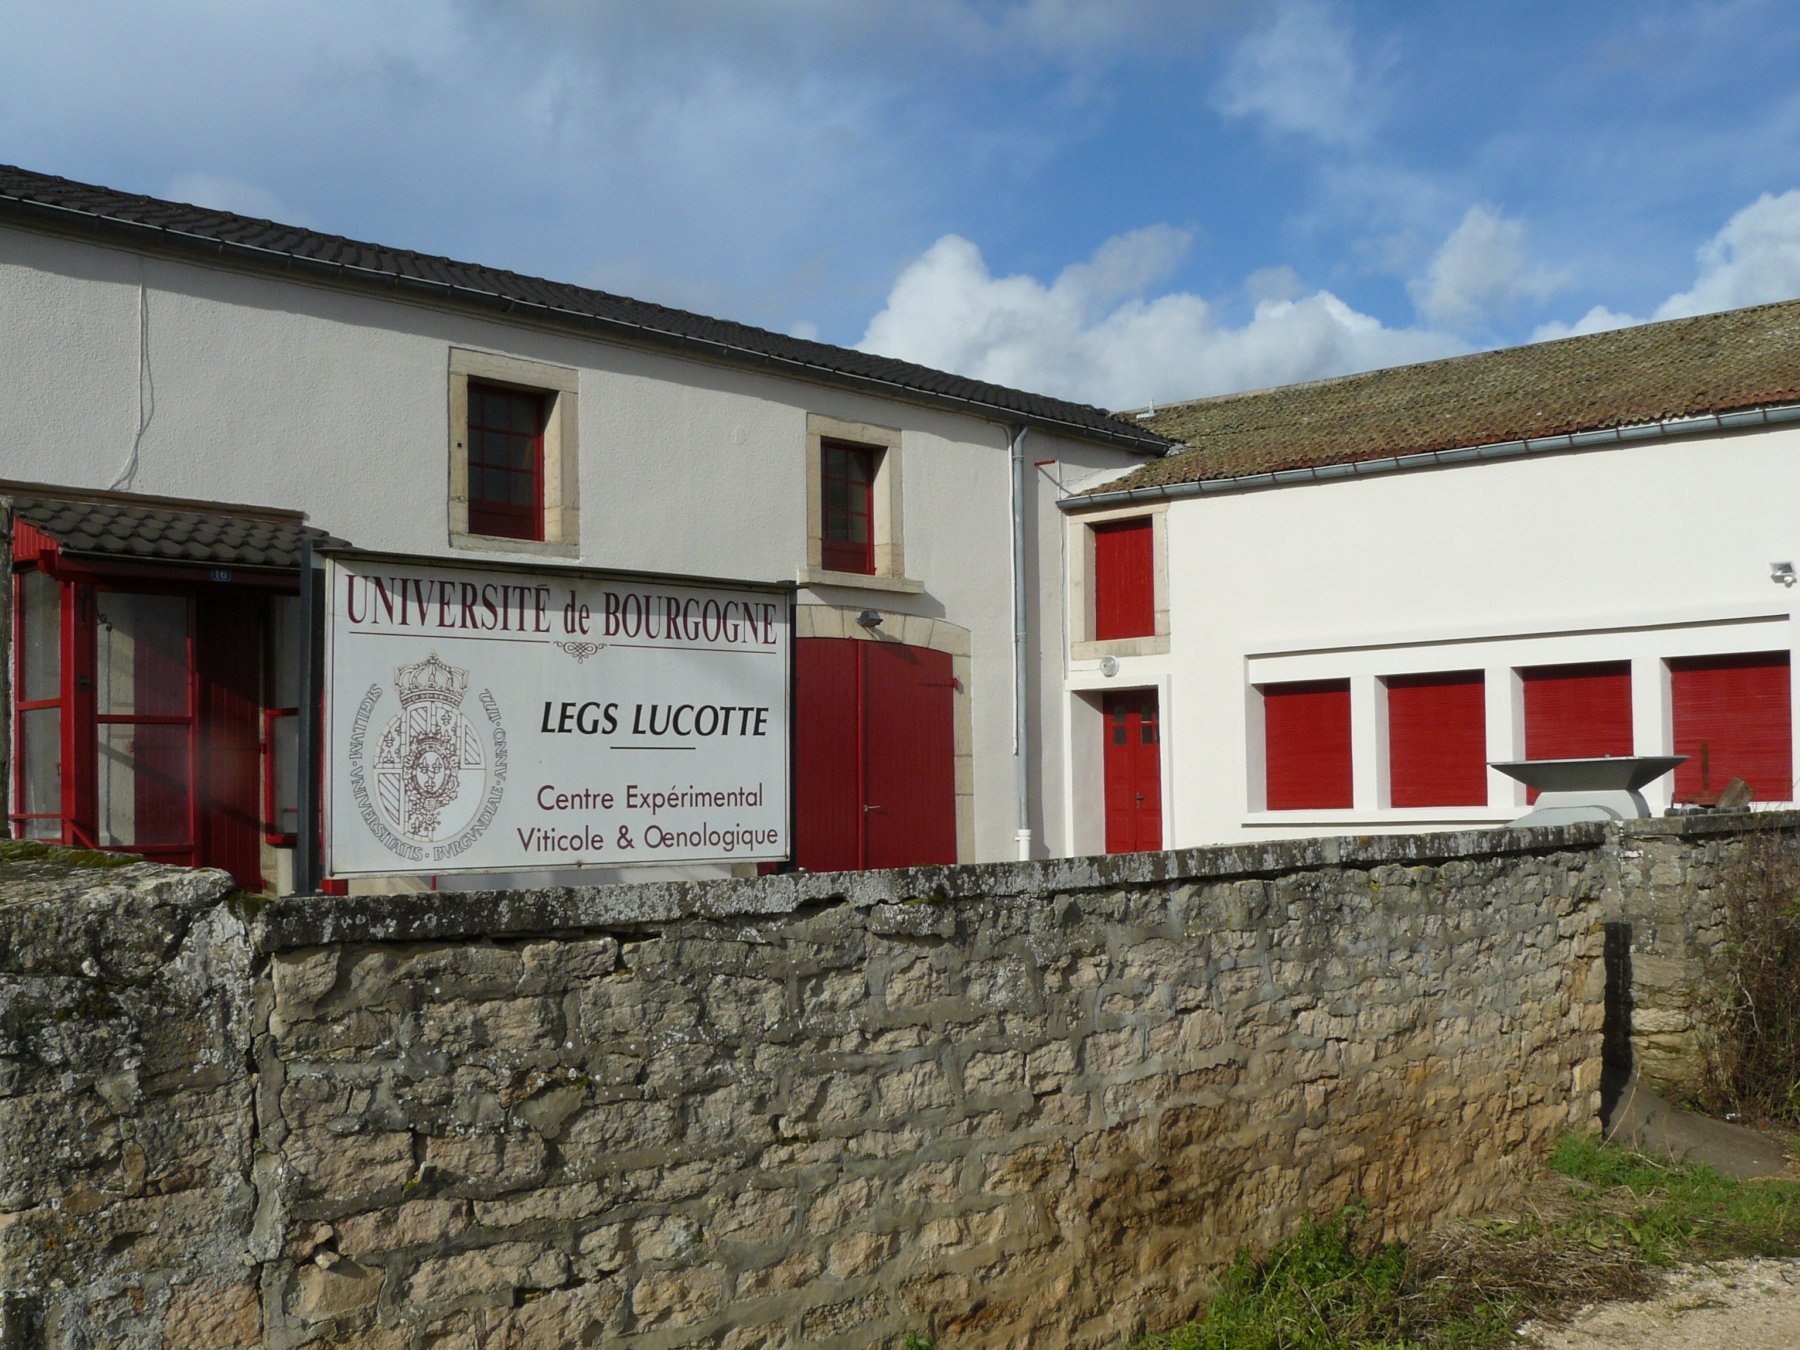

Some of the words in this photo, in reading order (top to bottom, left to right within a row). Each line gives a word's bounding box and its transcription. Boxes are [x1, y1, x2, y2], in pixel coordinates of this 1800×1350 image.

[215, 569, 228, 579] 16
[345, 574, 551, 633] UNIVERSITÉ
[563, 589, 590, 636] de
[602, 592, 777, 645] BOURGOGNE
[540, 701, 619, 735] LEGS
[631, 703, 769, 737] LUCOTTE
[493, 727, 508, 781] ANNO
[537, 784, 614, 811] Centre
[626, 782, 763, 816] Expérimental
[517, 824, 604, 852] Viticole
[616, 824, 635, 850] &
